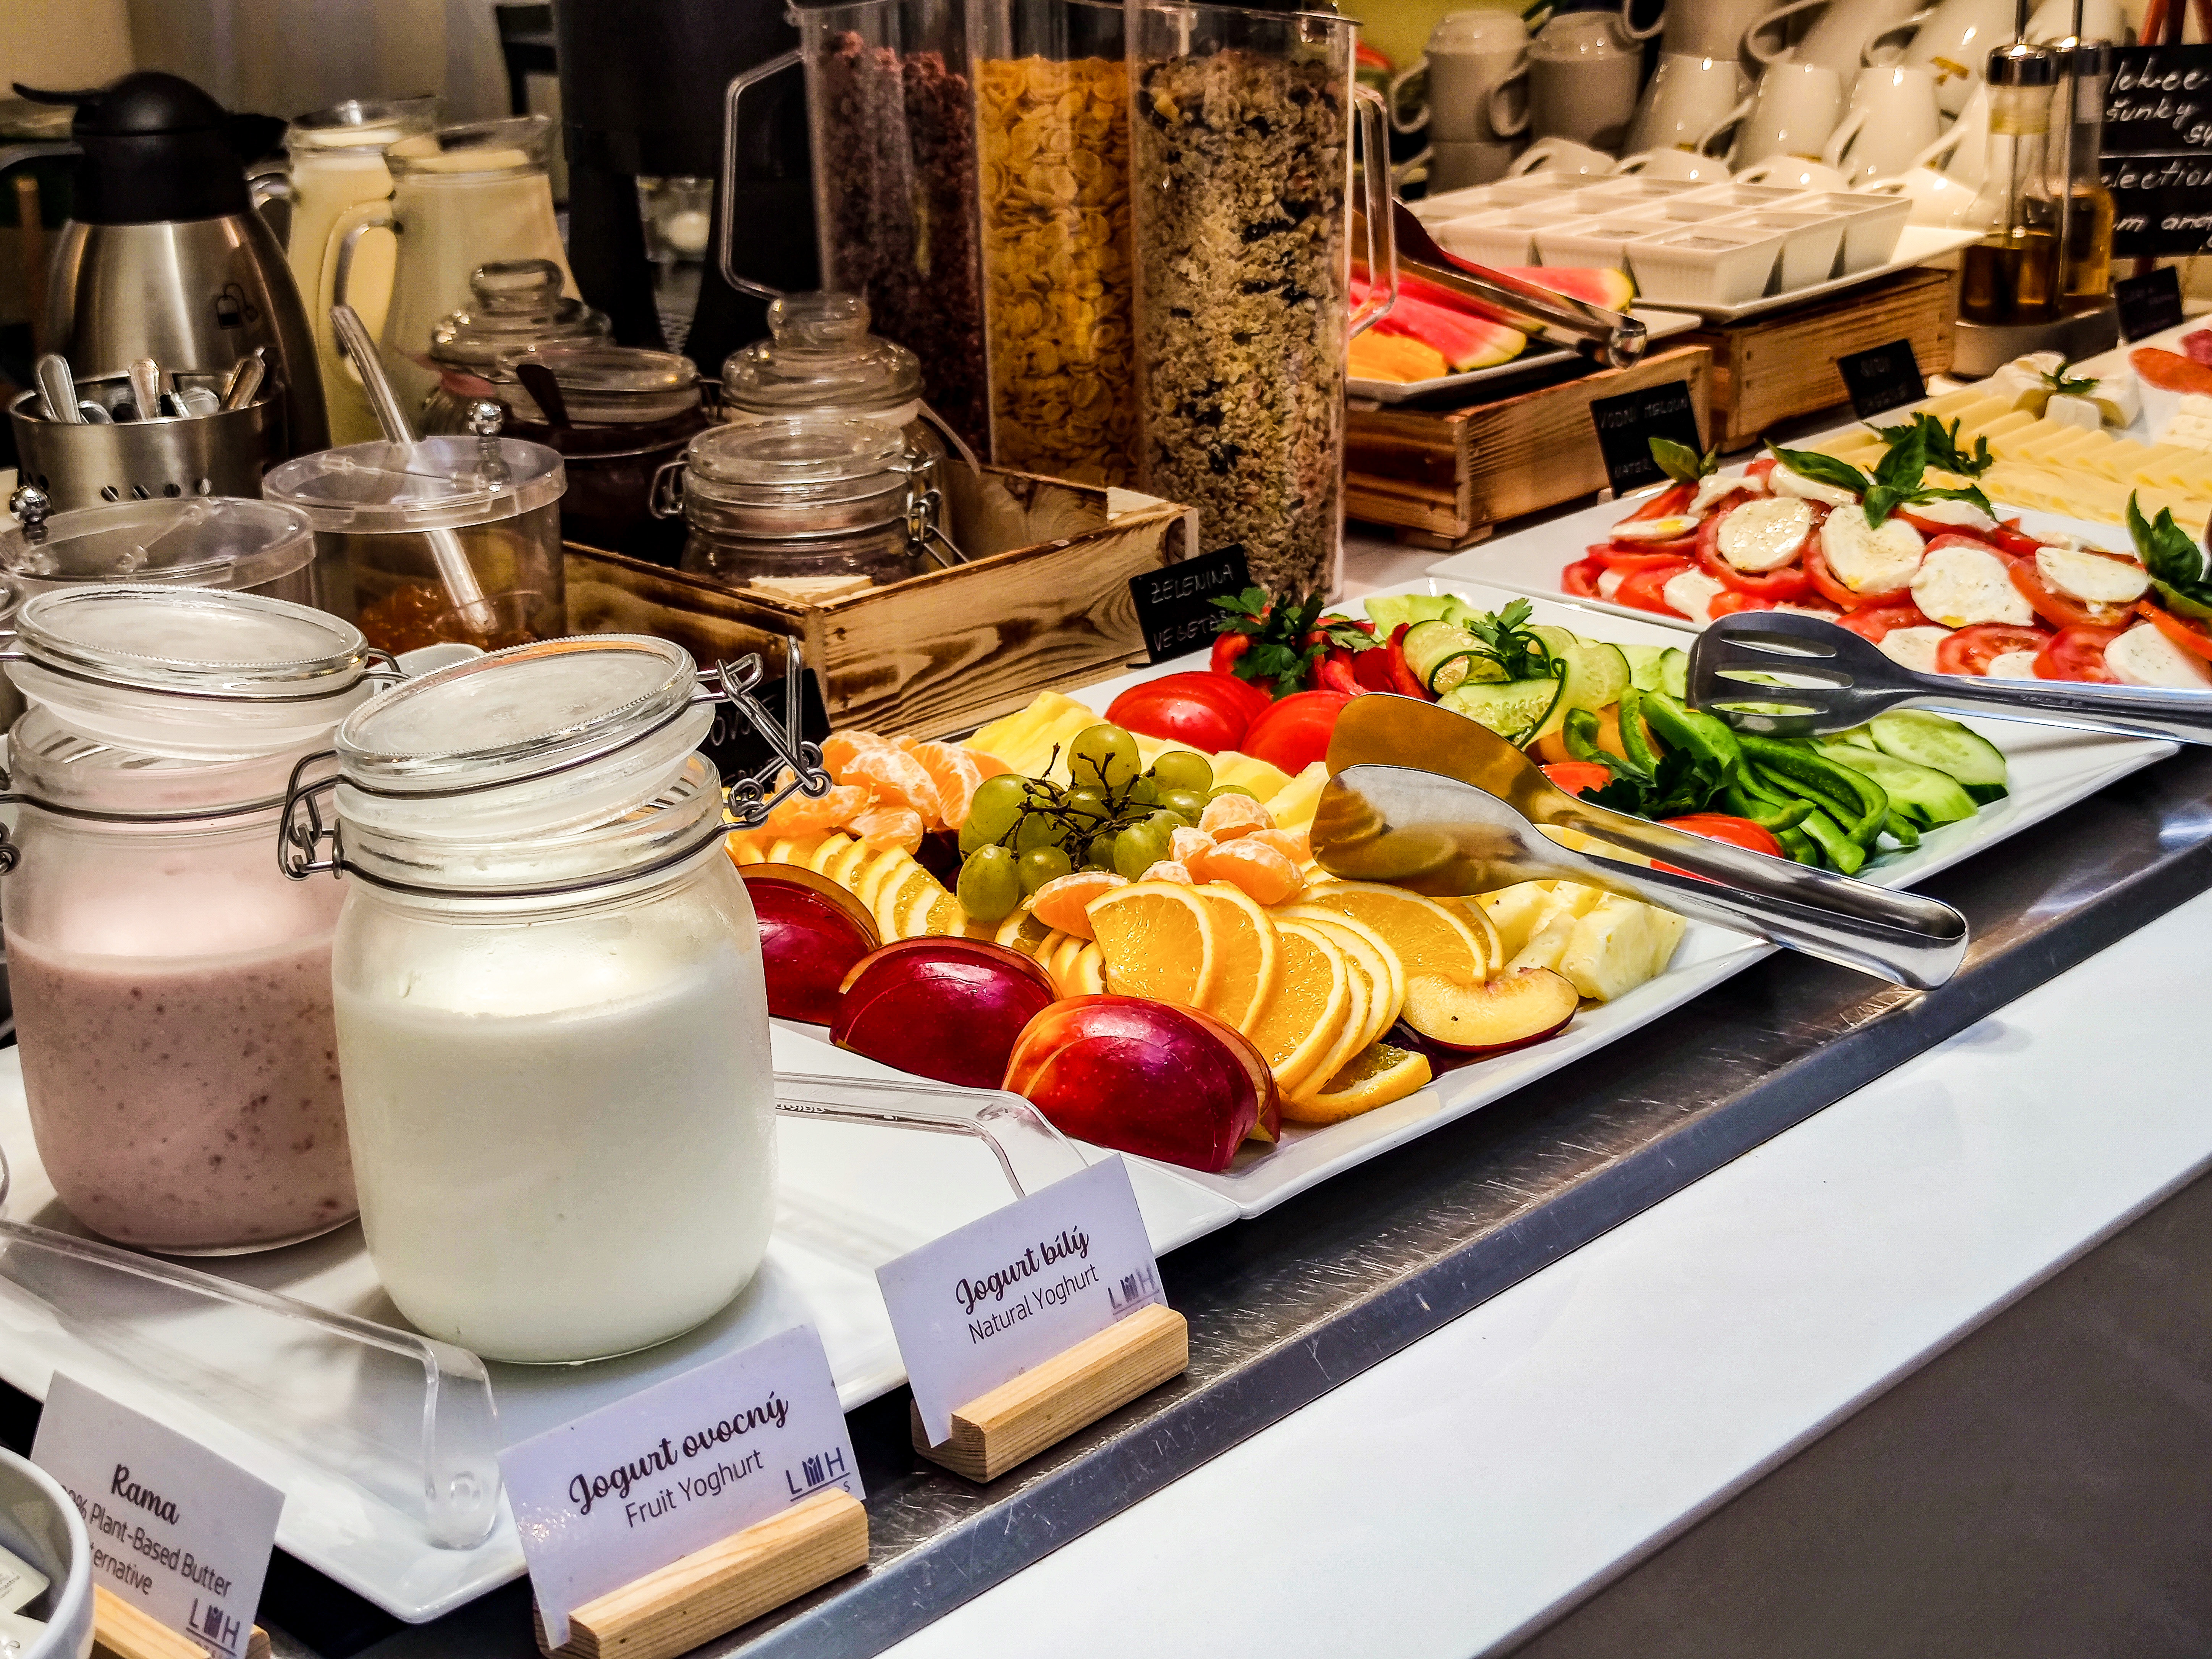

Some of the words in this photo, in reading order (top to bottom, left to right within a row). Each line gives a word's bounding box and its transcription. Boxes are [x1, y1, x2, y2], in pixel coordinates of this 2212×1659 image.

[1153, 610, 1228, 652] VEGETAB
[956, 1248, 1040, 1315] Jogurt
[1041, 1226, 1090, 1266] bílý
[968, 1303, 1034, 1344] Natural
[1035, 1264, 1100, 1310] Yoghurt
[569, 1437, 678, 1515] Jogurt
[682, 1391, 789, 1457] ovocný
[625, 1490, 677, 1528] Fruit
[678, 1449, 765, 1502] Yoghurt
[111, 1463, 179, 1525] Rama
[90, 1502, 181, 1570] Plant-Based
[182, 1553, 232, 1597] Butter
[90, 1541, 153, 1595] ernative
